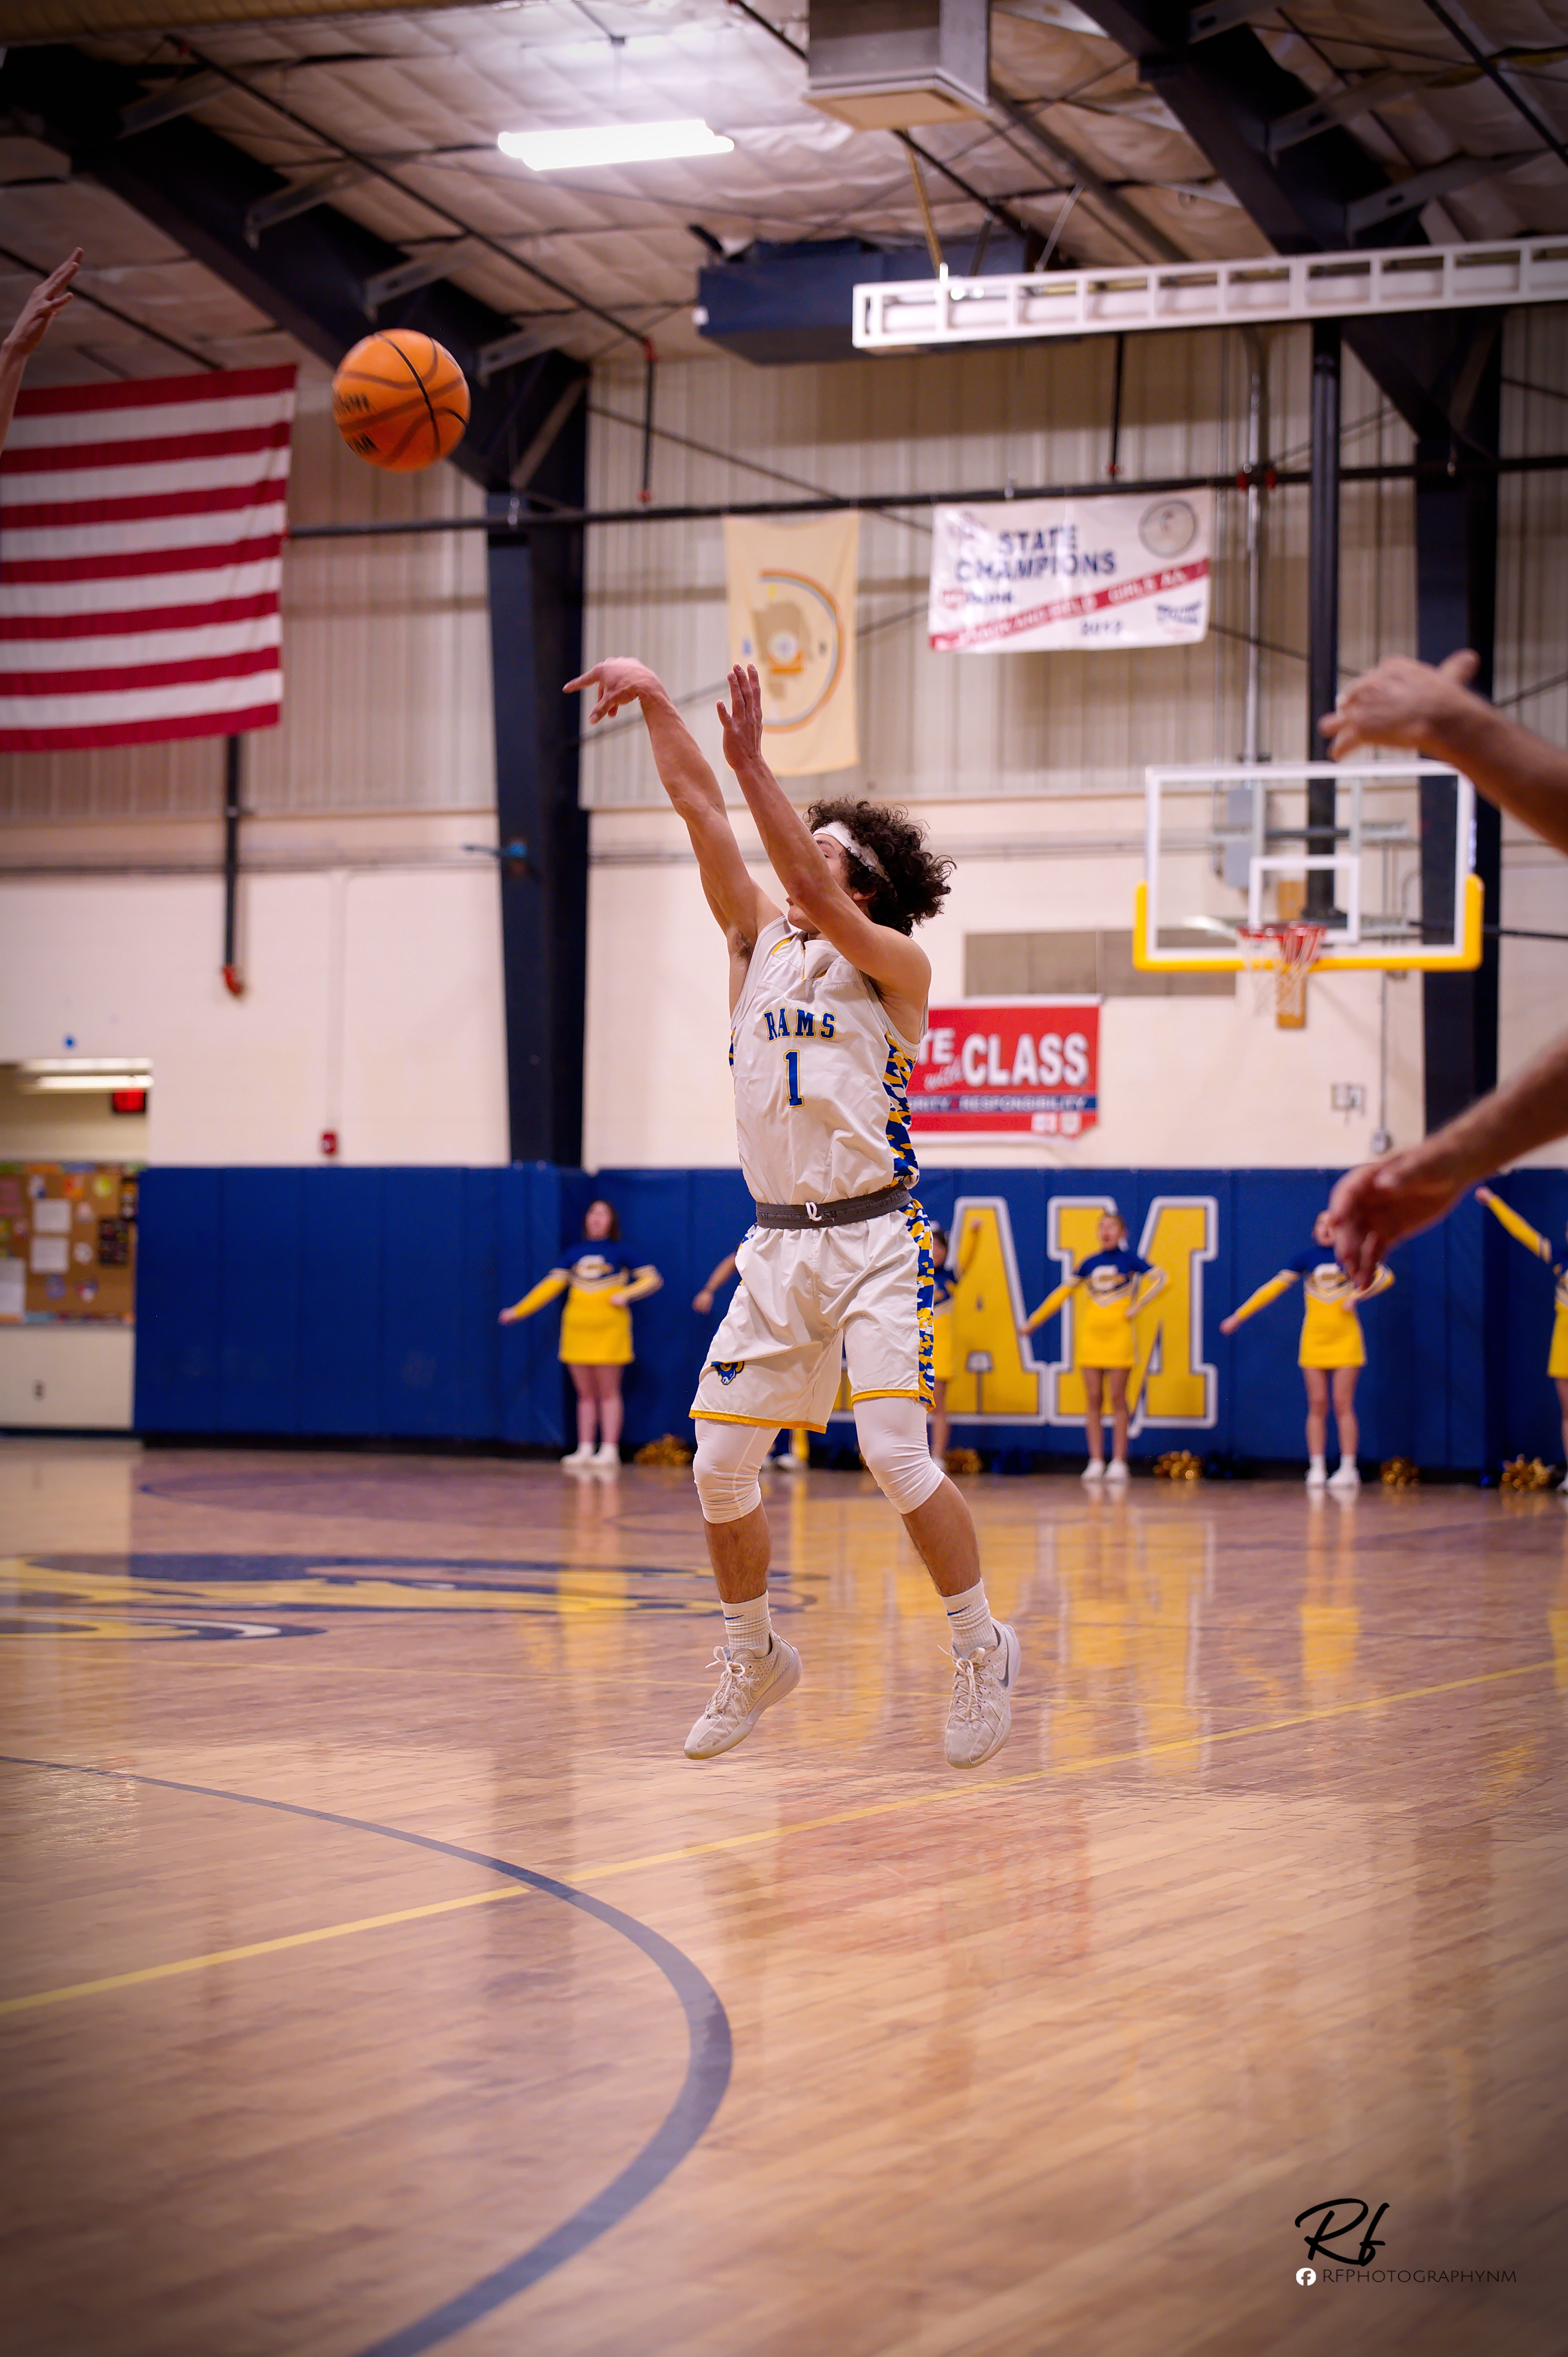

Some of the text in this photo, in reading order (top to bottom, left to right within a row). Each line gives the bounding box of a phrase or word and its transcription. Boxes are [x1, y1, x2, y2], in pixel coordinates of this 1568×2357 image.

[999, 525, 1077, 553] STATE
[955, 551, 1117, 581] CHAMPIONS
[763, 1006, 837, 1043] RAMS
[961, 1032, 1090, 1087] CLASS
[783, 1049, 805, 1108] 1
[958, 1095, 1087, 1112] RESPONSIBILITY
[927, 1195, 1218, 1429] AM
